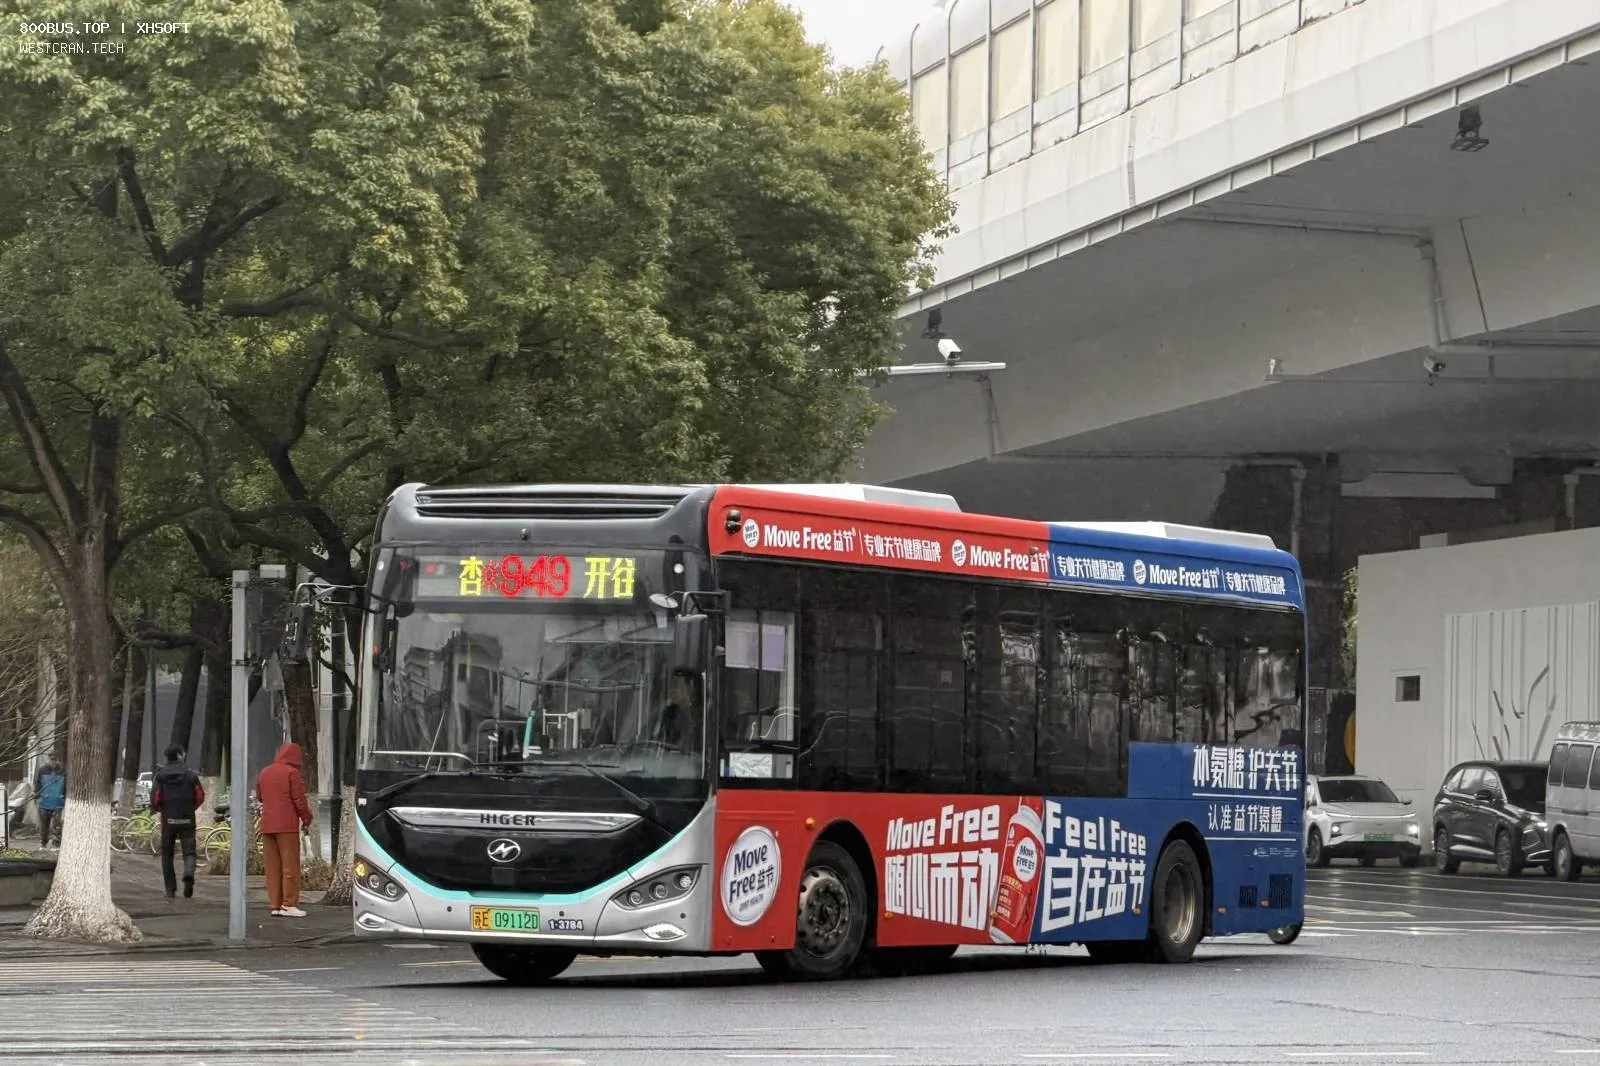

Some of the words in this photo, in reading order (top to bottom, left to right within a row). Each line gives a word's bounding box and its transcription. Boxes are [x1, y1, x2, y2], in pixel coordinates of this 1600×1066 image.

[764, 524, 800, 548] Move
[803, 527, 831, 551] Free
[864, 533, 942, 563] 专业关节健康品牌
[970, 545, 1001, 568] Move
[1003, 548, 1029, 571] Free
[500, 555, 572, 599] 949
[1149, 564, 1177, 585] Move
[1179, 566, 1201, 588] Free
[1192, 745, 1245, 789] 补氨糖
[1248, 748, 1297, 791] 护关节
[480, 813, 536, 826] HIGER
[886, 817, 935, 850] Move
[939, 804, 1000, 846] Free
[1046, 800, 1105, 852] Feel
[1111, 819, 1146, 856] Free
[734, 844, 767, 875] Move
[1015, 856, 1028, 867] Free
[1019, 845, 1034, 858] Move
[729, 872, 755, 903] Free
[885, 847, 999, 931] 随心而动
[1041, 848, 1146, 933] 自在益节
